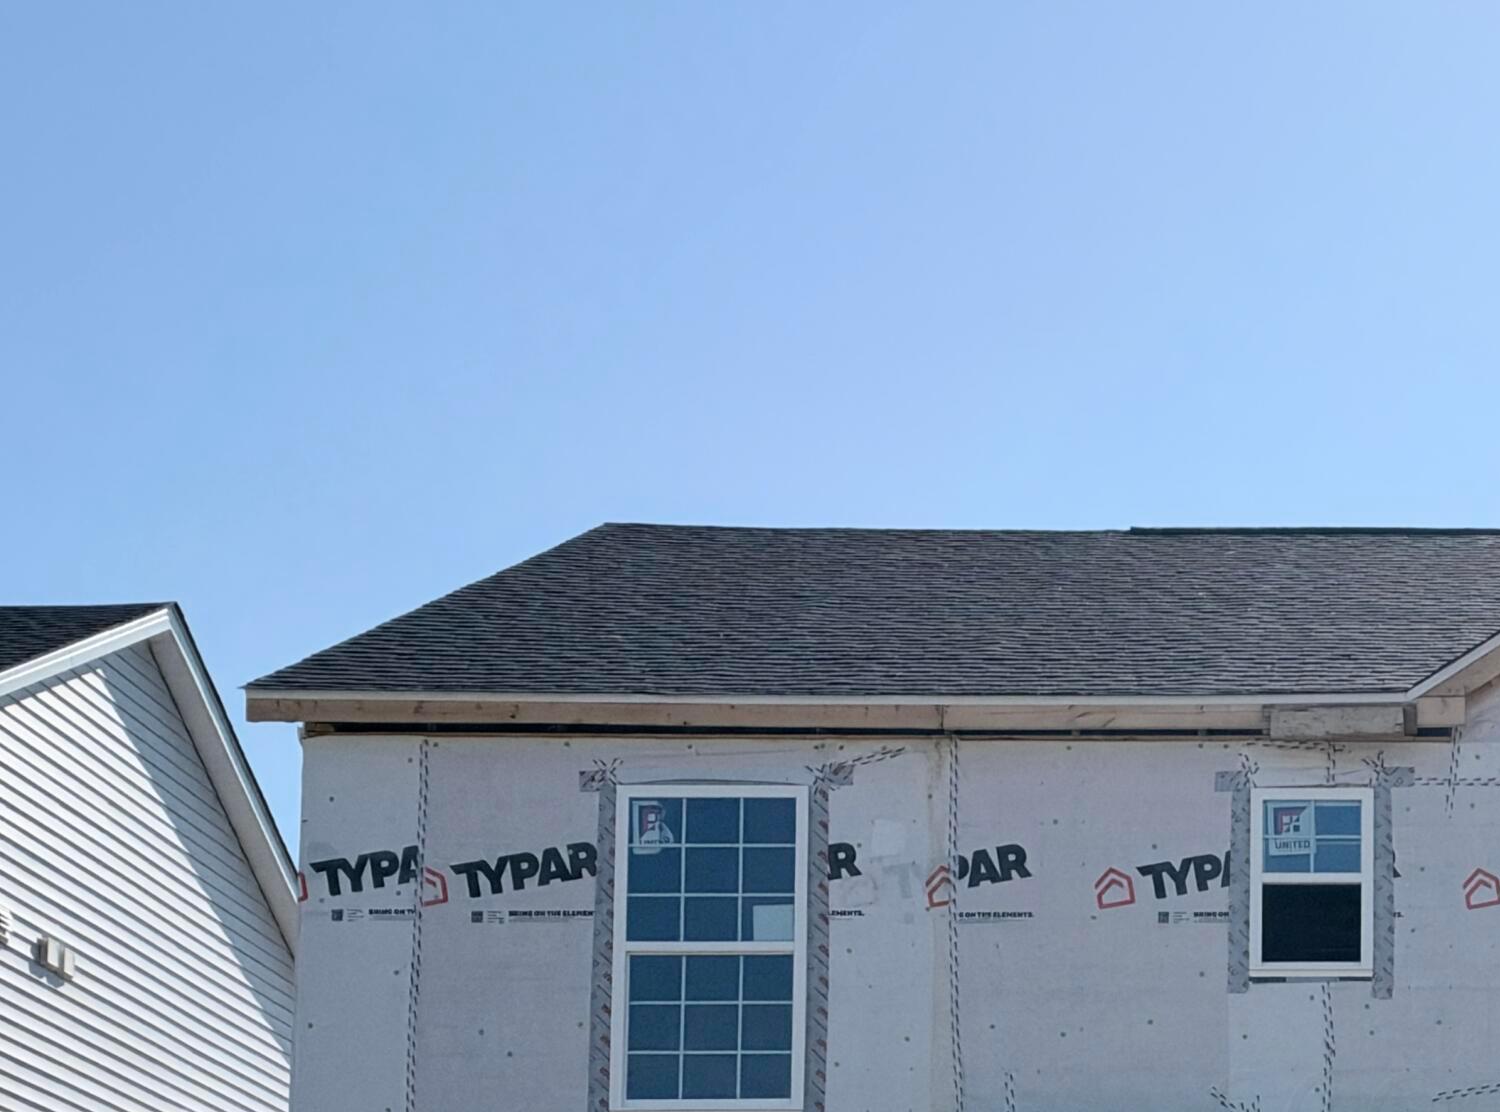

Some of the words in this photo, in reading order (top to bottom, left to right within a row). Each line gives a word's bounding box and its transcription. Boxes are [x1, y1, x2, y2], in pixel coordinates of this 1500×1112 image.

[1274, 840, 1311, 849] UNITED
[450, 842, 597, 898] TYPAR
[1136, 851, 1230, 899] TYP
